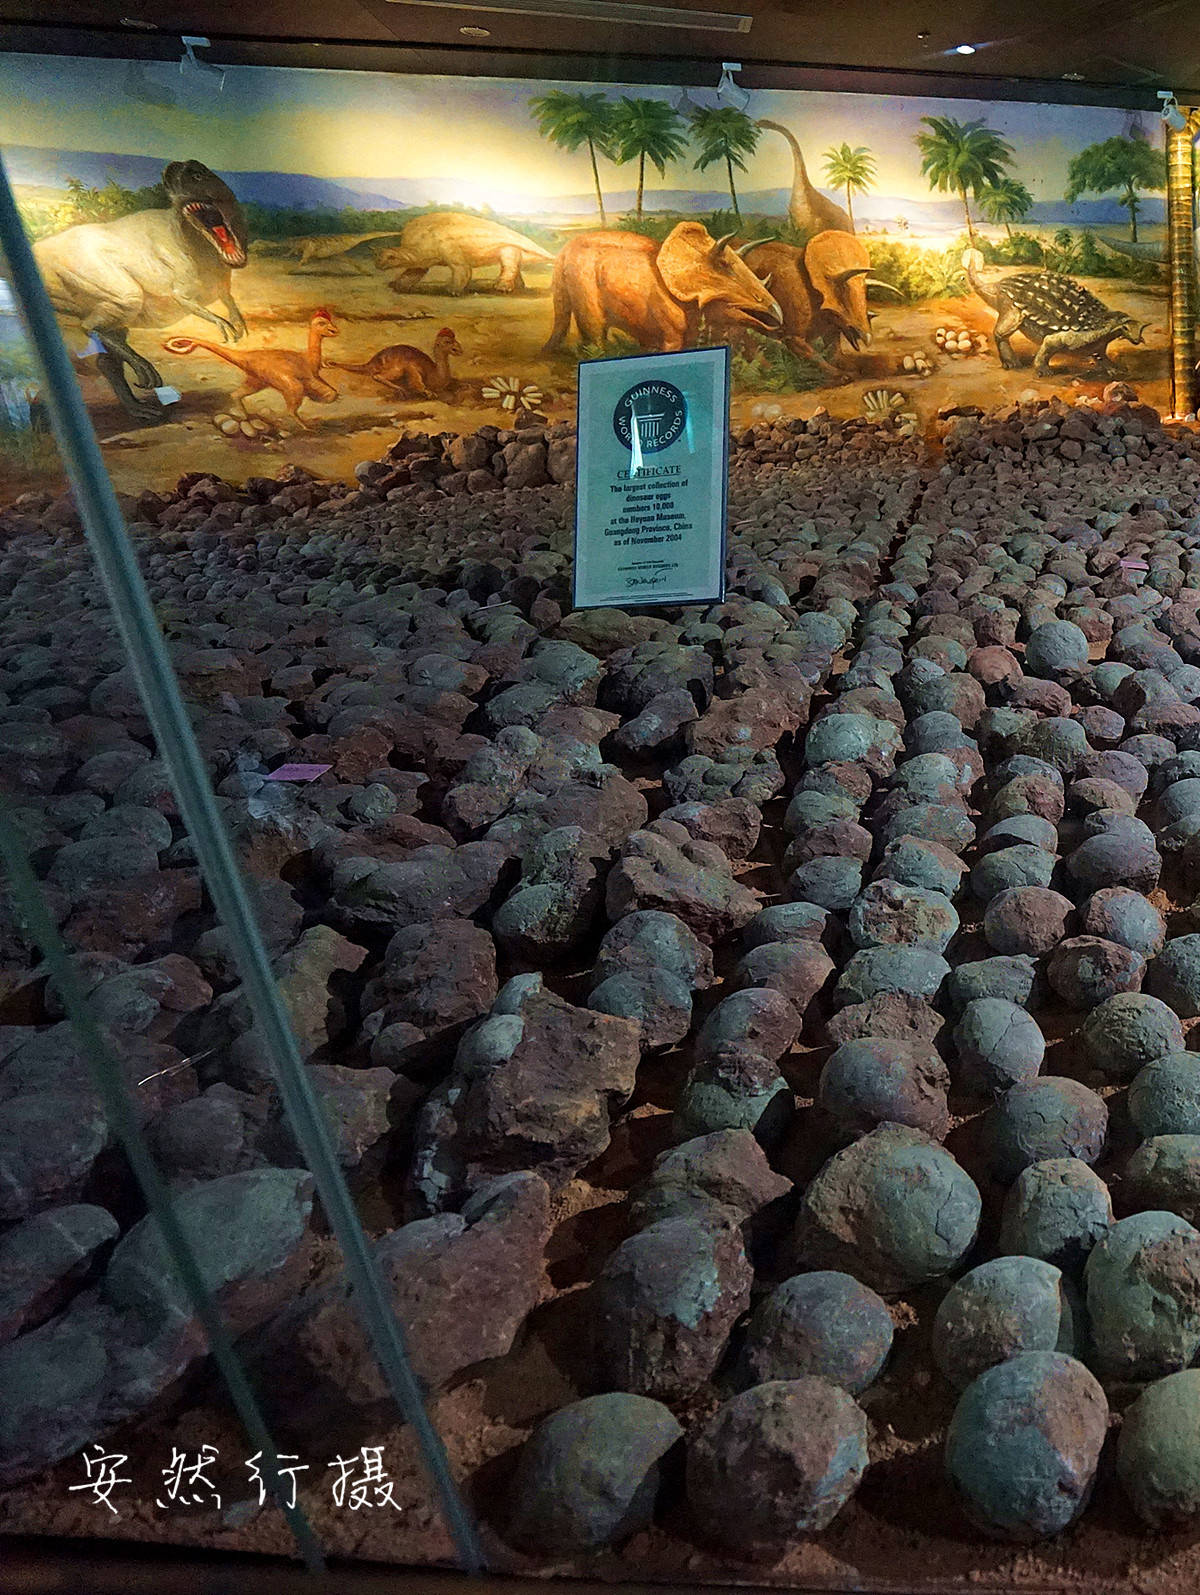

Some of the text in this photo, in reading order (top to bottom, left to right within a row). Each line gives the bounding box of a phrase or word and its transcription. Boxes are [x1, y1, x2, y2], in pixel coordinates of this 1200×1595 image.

[624, 386, 678, 408] GUINNESS
[618, 410, 683, 449] WOR RECORDS
[616, 465, 682, 480] CETIFICATE
[610, 479, 689, 493] The largest collection of
[626, 492, 672, 502] dinosaur eggs
[622, 504, 650, 513] numbers
[618, 516, 629, 524] the
[604, 527, 640, 537] Guangdong
[673, 521, 693, 530] China
[631, 535, 664, 545] November
[665, 533, 682, 542] 2004
